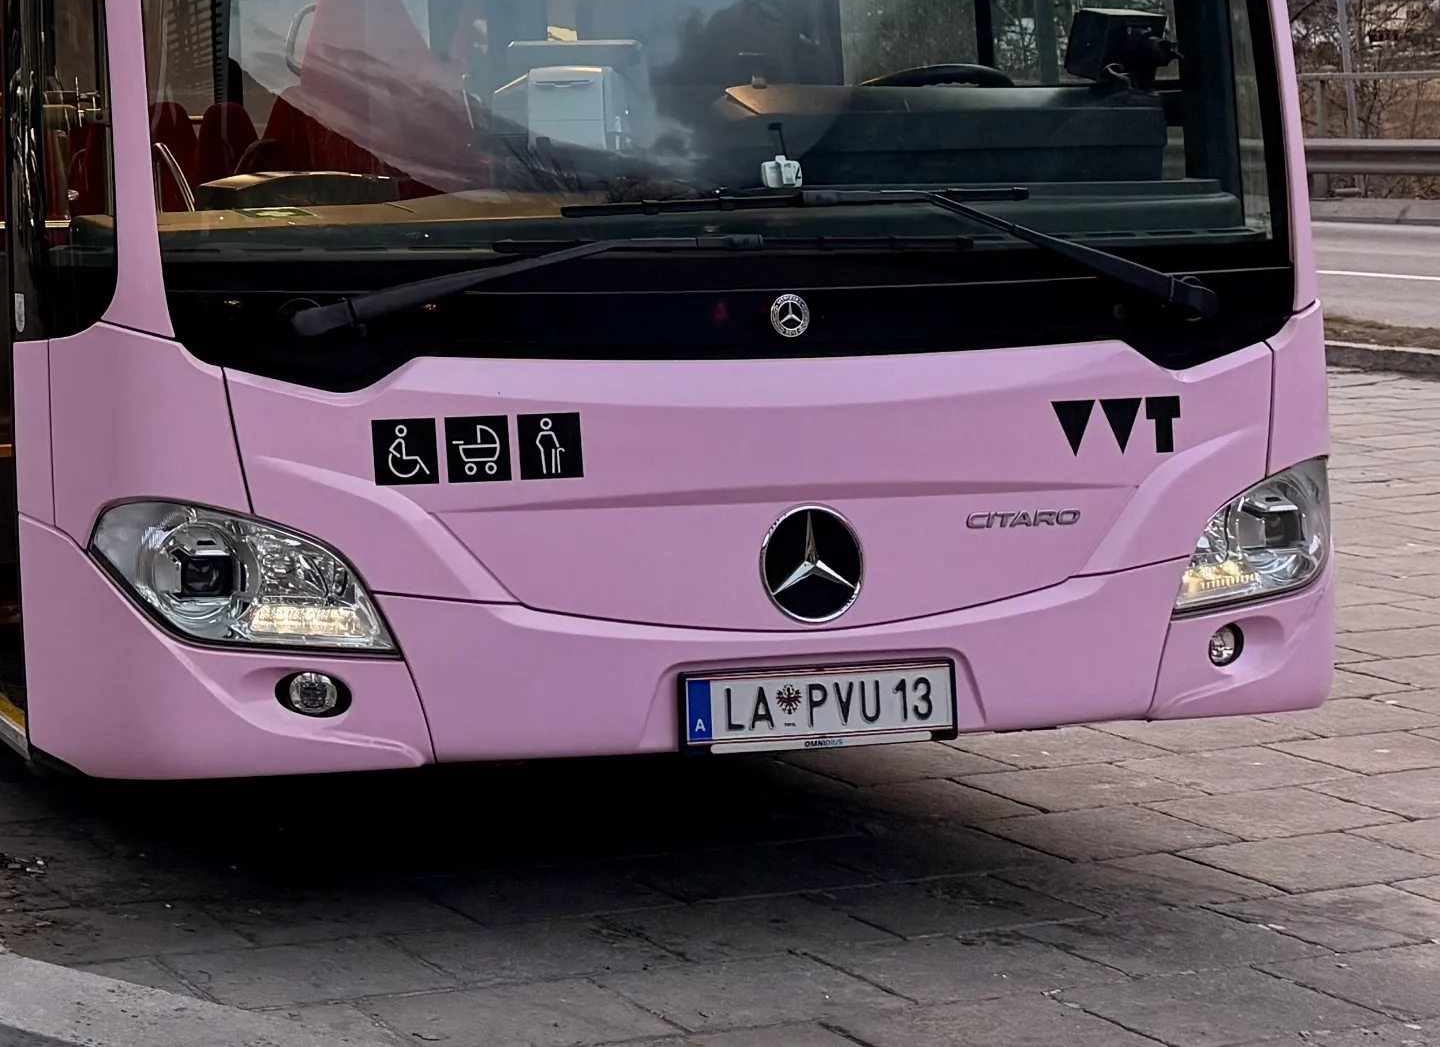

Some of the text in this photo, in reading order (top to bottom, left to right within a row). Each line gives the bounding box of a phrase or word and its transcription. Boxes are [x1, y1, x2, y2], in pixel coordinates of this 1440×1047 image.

[1050, 395, 1181, 457] VVT
[965, 508, 1081, 530] CITARO
[725, 676, 933, 731] LA PVU 13
[695, 718, 706, 732] A
